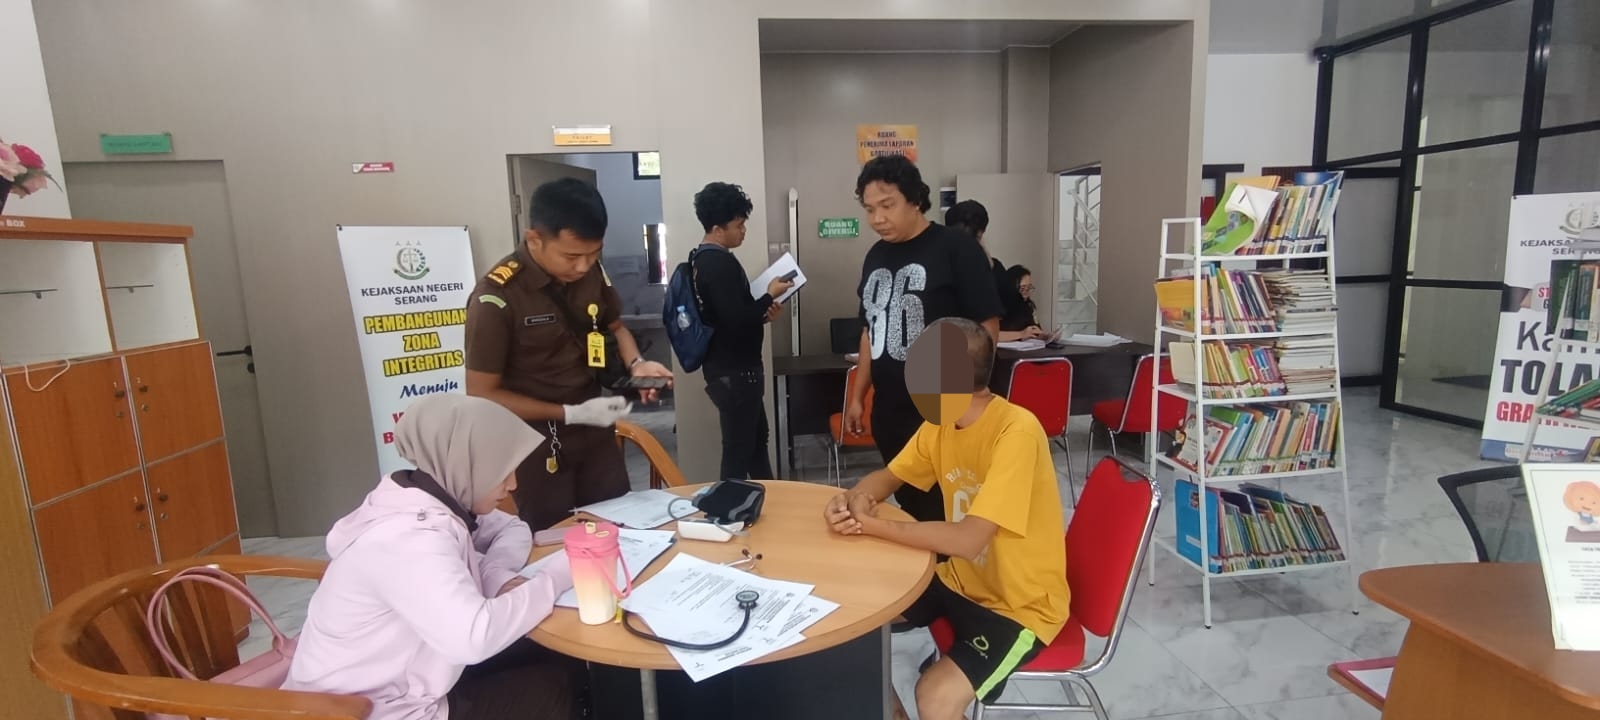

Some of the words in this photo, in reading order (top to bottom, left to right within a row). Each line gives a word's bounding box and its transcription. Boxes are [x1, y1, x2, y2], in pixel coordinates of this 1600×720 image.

[361, 284, 424, 297] KEJAKSAAN
[426, 282, 464, 293] NEGERI
[394, 294, 438, 305] SERANG
[363, 308, 467, 334] PEMBANGUNAN
[863, 263, 927, 361] 86
[402, 332, 441, 353] ZONA
[383, 350, 465, 377] INTEGRITAS
[400, 379, 458, 399] Menuju
